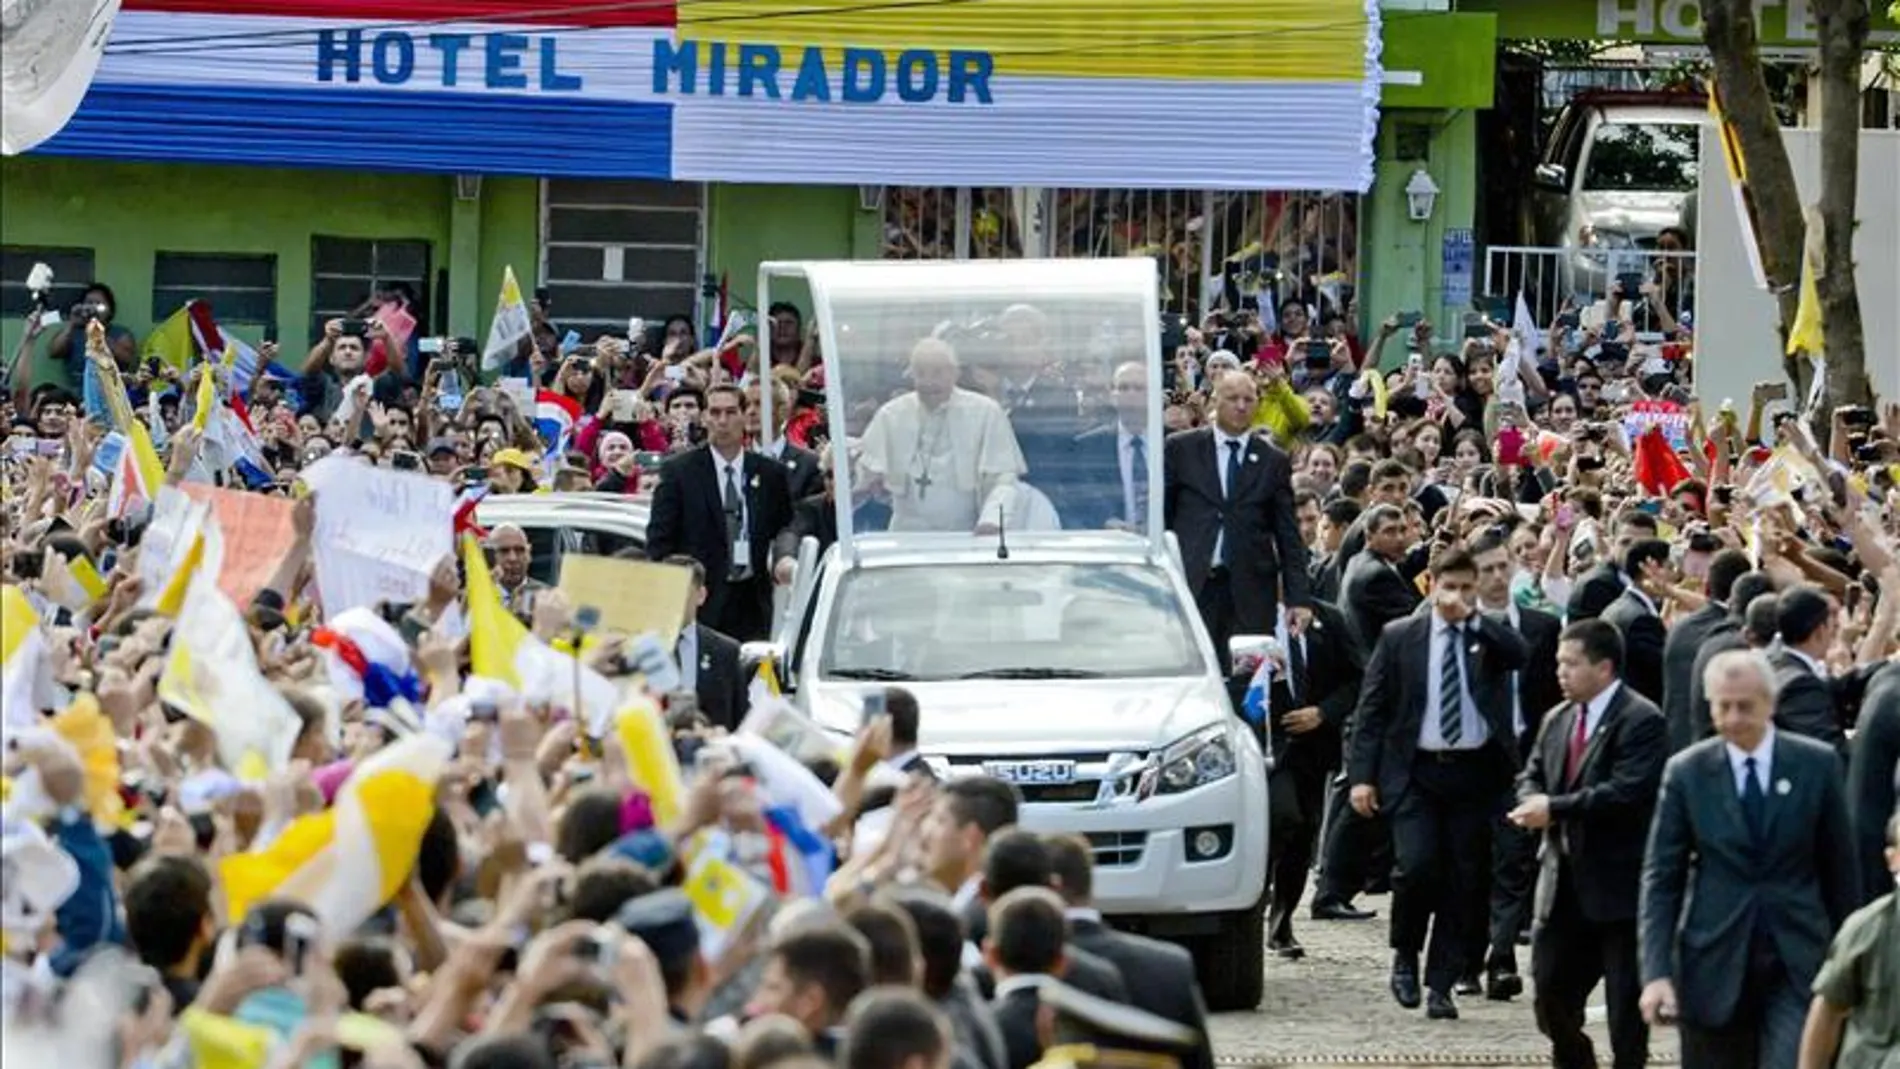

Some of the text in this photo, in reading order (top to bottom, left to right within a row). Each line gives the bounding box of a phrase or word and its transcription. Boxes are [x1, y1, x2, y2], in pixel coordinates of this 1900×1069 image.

[317, 29, 995, 104] HOTEL MIRADOR
[985, 763, 1074, 782] ISUZU
